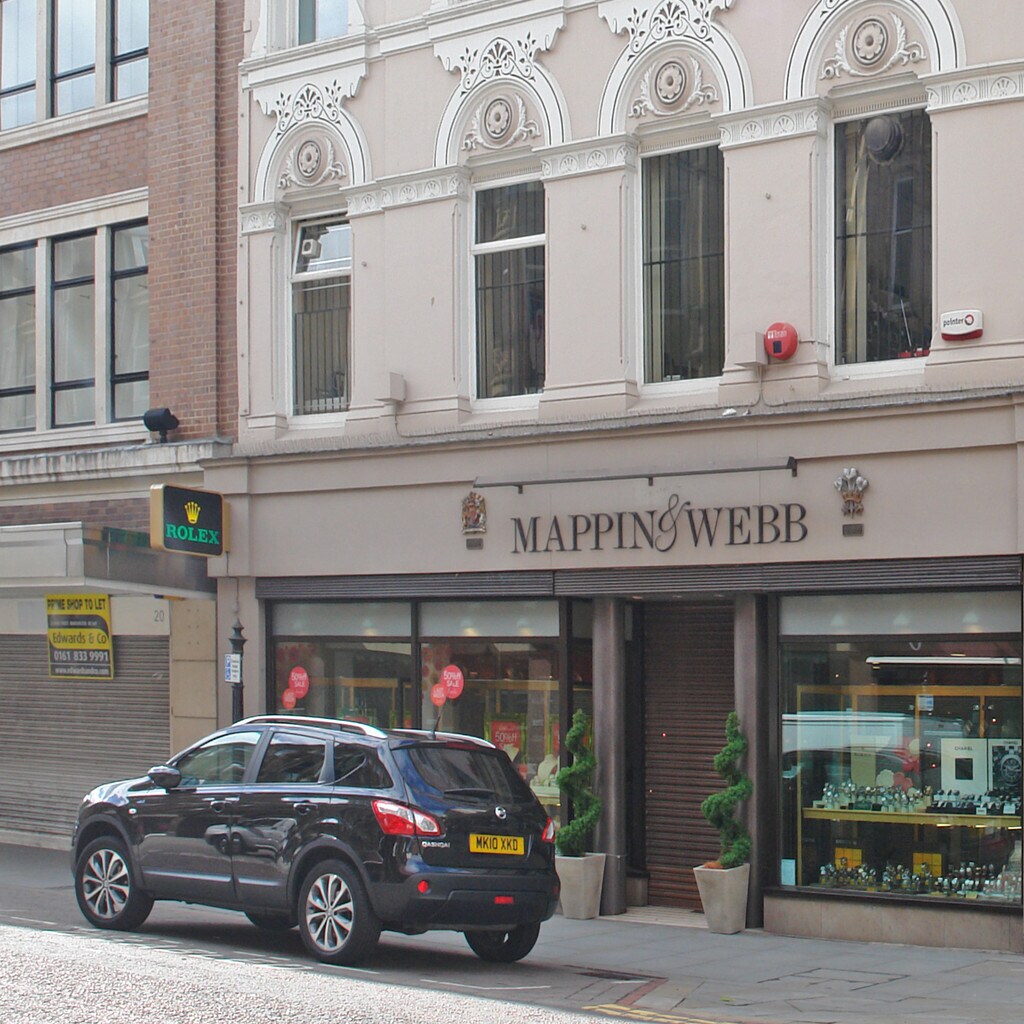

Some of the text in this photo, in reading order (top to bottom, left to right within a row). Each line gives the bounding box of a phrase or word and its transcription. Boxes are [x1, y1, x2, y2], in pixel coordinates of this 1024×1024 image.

[165, 522, 220, 545] ROLEX
[66, 598, 83, 610] SHOP
[84, 598, 93, 610] TO
[94, 598, 106, 610] LET
[153, 609, 165, 623] 20
[52, 632, 107, 645] Edwards & Co
[53, 650, 109, 662] 0161 833 9991
[476, 835, 499, 849] MK10
